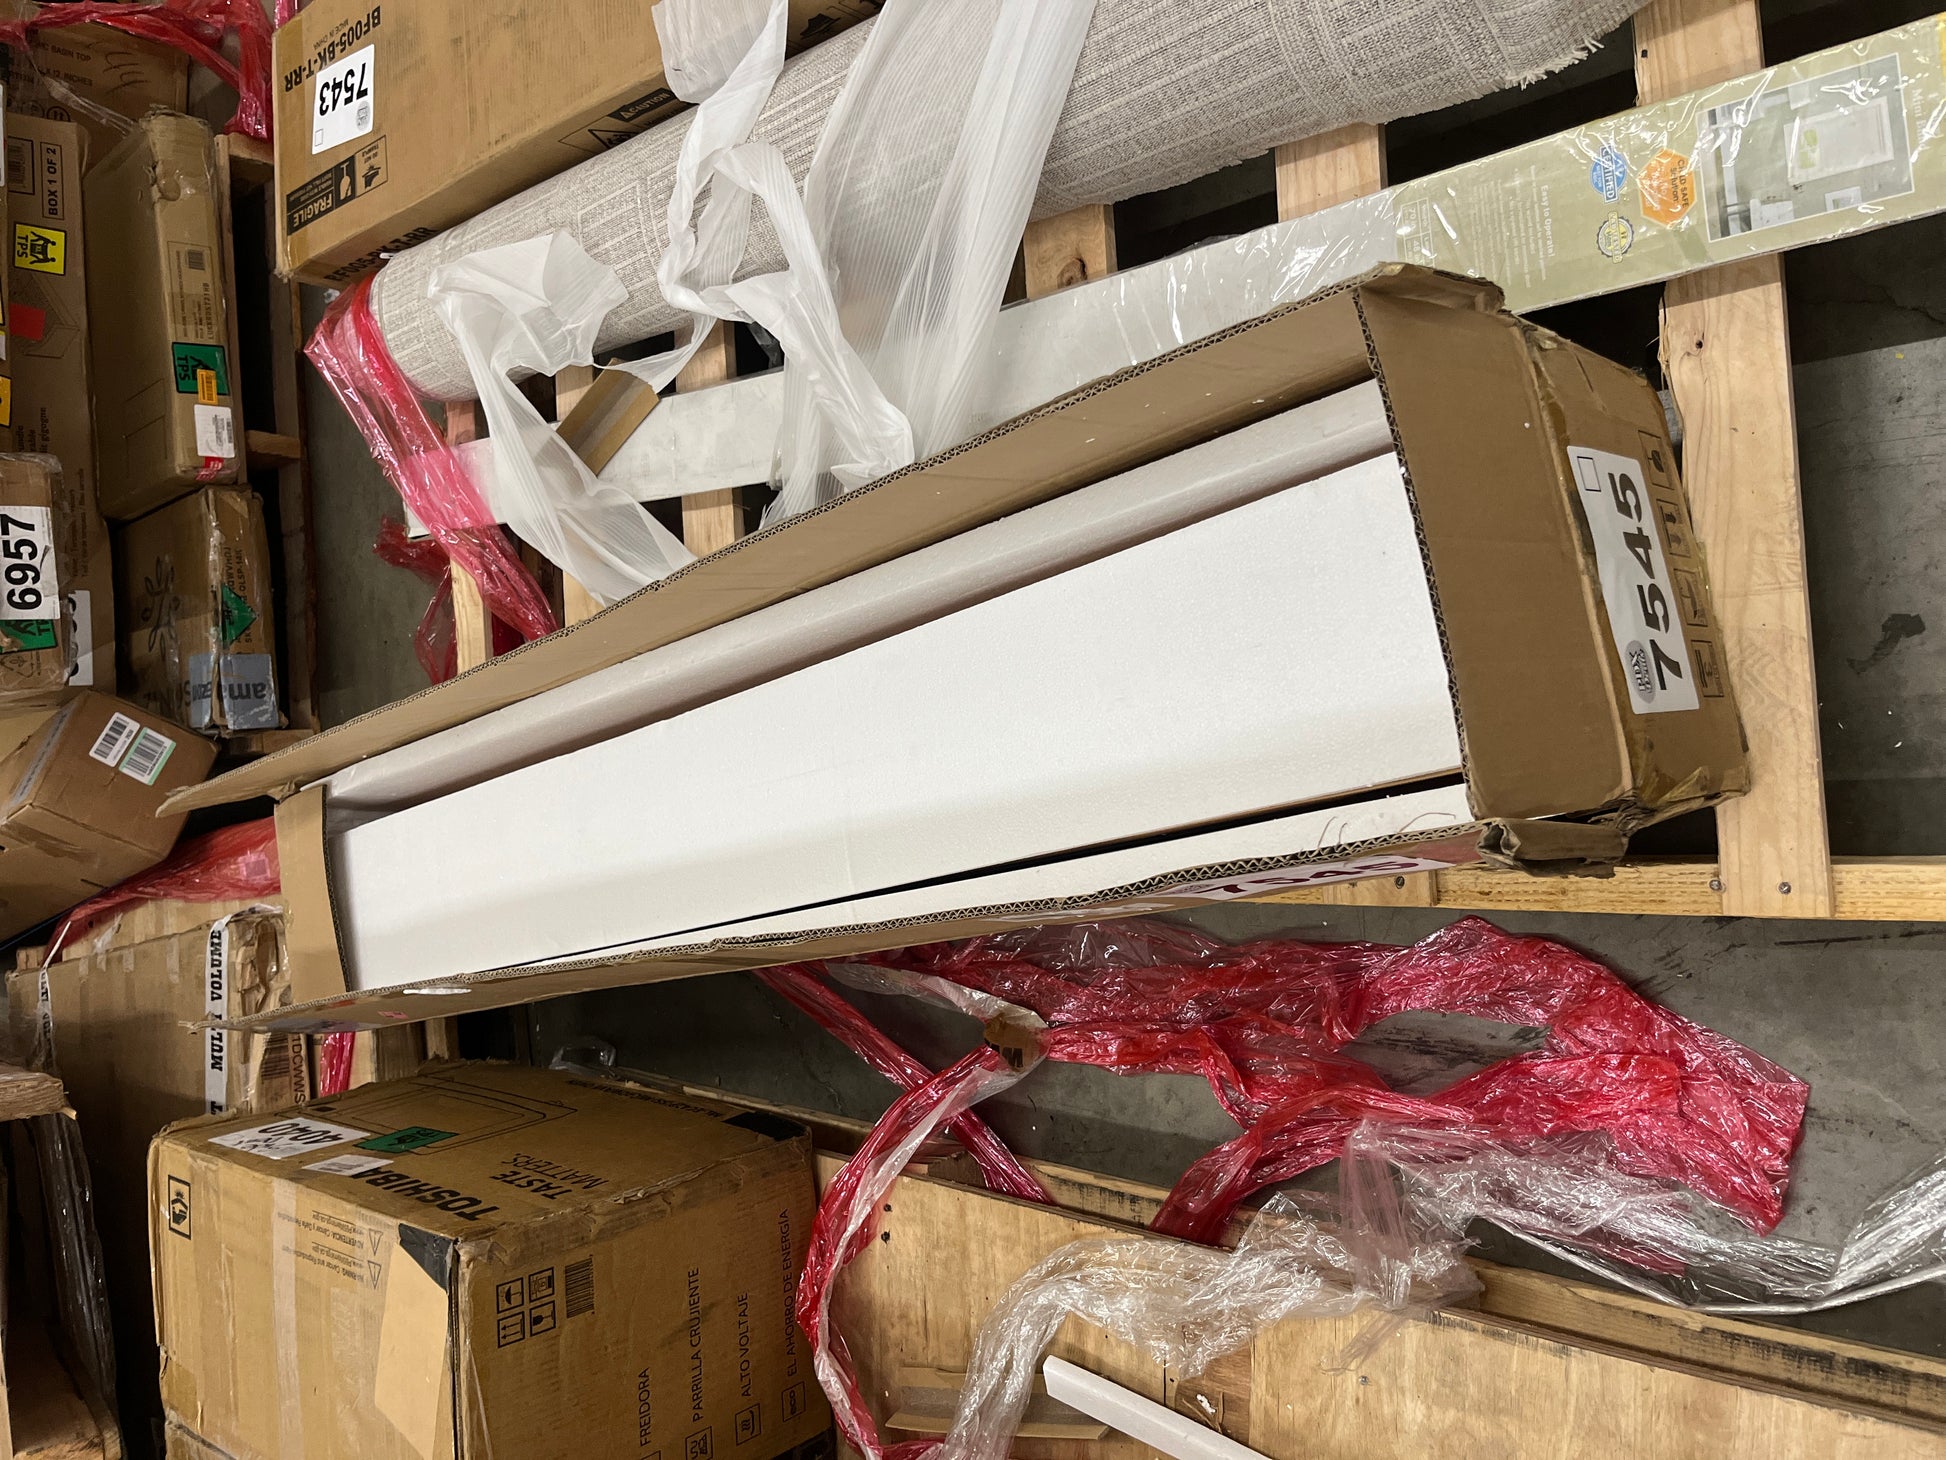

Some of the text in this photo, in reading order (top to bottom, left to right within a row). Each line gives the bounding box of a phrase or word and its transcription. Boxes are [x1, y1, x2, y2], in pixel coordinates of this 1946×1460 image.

[284, 5, 381, 92] BF005-BK-T-RR
[319, 63, 369, 117] 7543
[629, 92, 670, 116] CAUTION
[46, 147, 56, 155] 2
[47, 157, 57, 174] OF
[48, 194, 58, 216] BOX
[293, 192, 333, 227] FRAGILE
[1541, 185, 1549, 207] Easy
[17, 235, 28, 258] TPS
[176, 355, 191, 381] TPS
[1, 514, 42, 610] 6957
[1608, 472, 1683, 691] 7545
[210, 929, 224, 1002] VOLUME
[258, 1123, 344, 1145] 4040
[490, 1170, 573, 1200] TASTE
[501, 1152, 609, 1190] MATTERS.
[351, 1166, 499, 1222] TOSHIBA
[778, 1208, 797, 1377] EL AHORRO DE ENERGÍA
[688, 1267, 704, 1422] PARRILLA CRUJIENTE
[738, 1292, 751, 1397] ALTO VOLTAJE
[638, 1367, 651, 1446] FREIDORA
[789, 1390, 797, 1415] eco
